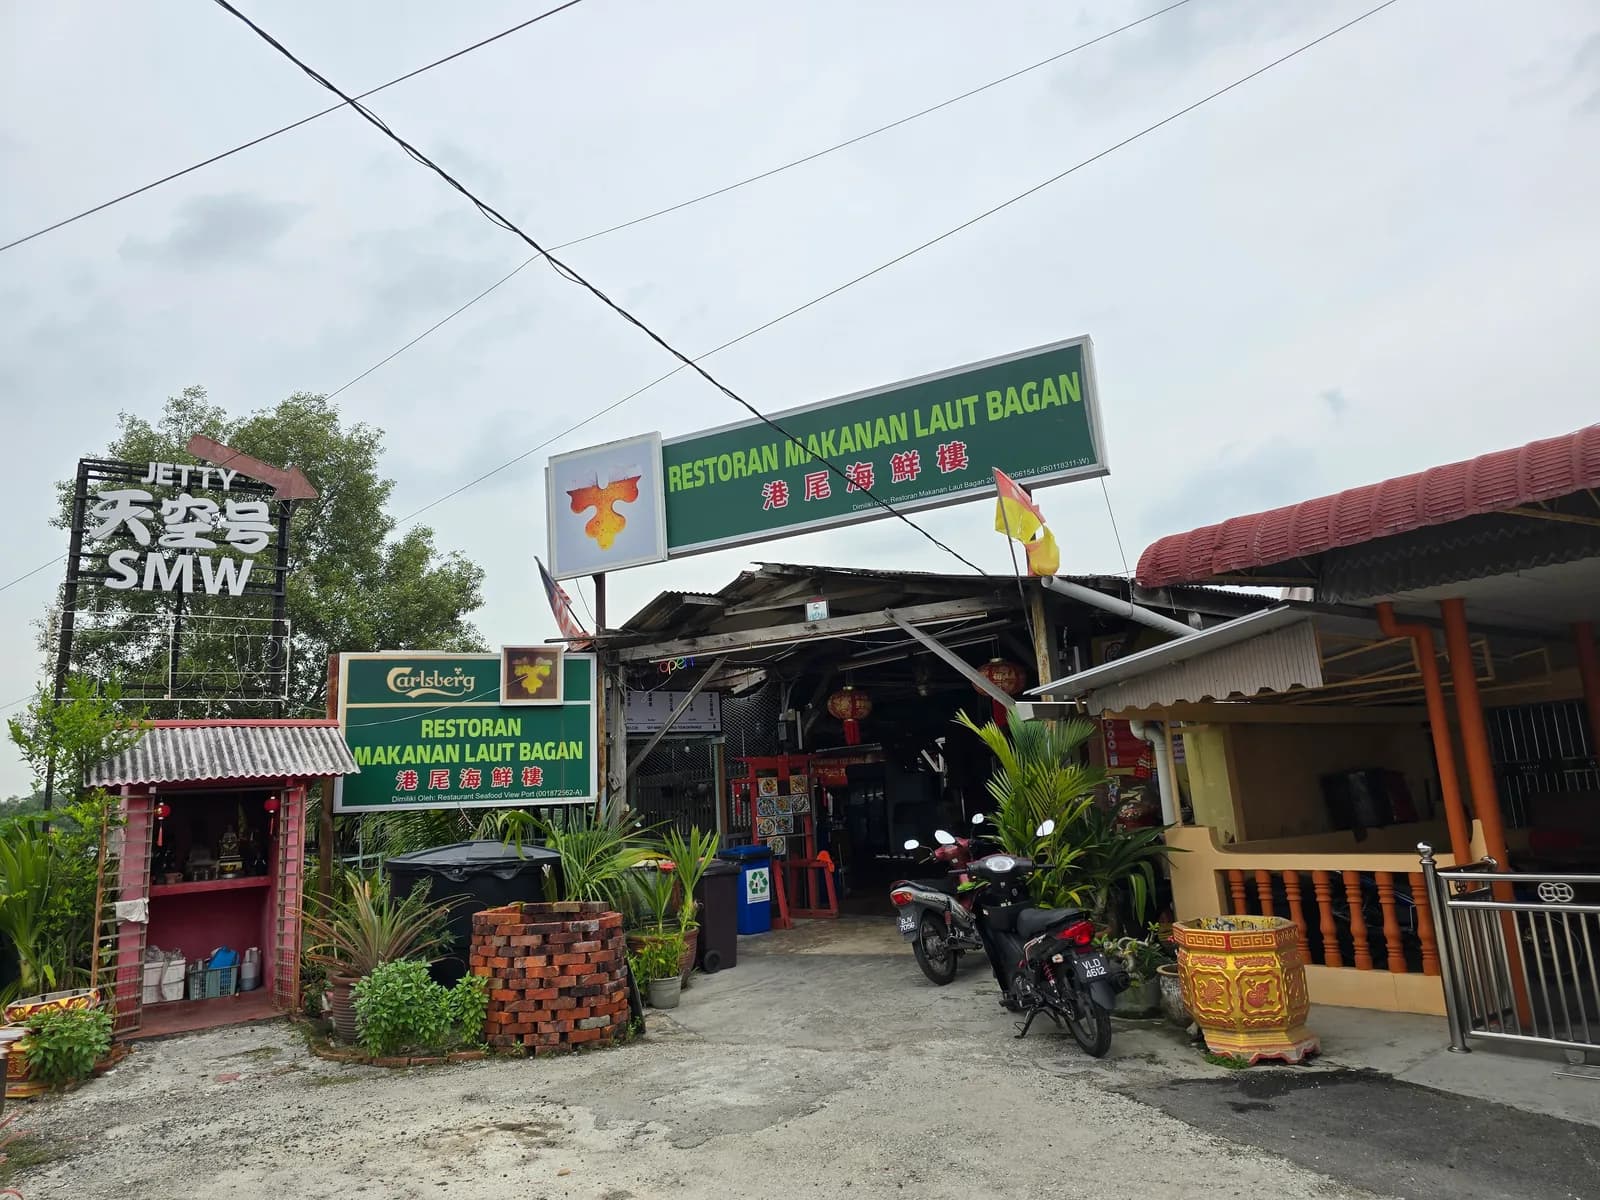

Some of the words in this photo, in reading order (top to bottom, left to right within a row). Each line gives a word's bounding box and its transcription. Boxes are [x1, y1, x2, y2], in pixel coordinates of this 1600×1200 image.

[668, 443, 778, 492] RESTORAN
[785, 412, 908, 468] MAKANAN
[913, 395, 979, 438] LAUT
[985, 372, 1081, 421] BAGAN
[141, 462, 238, 491] JETTY
[761, 441, 969, 511] 港尾海鮮樓
[919, 486, 948, 497] Makanan
[949, 482, 963, 491] Laut
[964, 478, 985, 488] Bagan
[90, 489, 278, 554] 天空号
[104, 550, 254, 596] SMW
[386, 667, 476, 698] Carlsberg
[421, 718, 522, 739] RESTORAN
[355, 743, 460, 766] MAKANAN
[464, 741, 515, 762] LAUT
[519, 740, 583, 762] BAGAN
[395, 766, 544, 791] 港尾海鮮樓
[437, 792, 474, 801] Restaurant
[475, 790, 503, 800] Seafood
[504, 791, 520, 799] View
[1082, 958, 1101, 969] VLD
[1086, 966, 1107, 978] 4612
